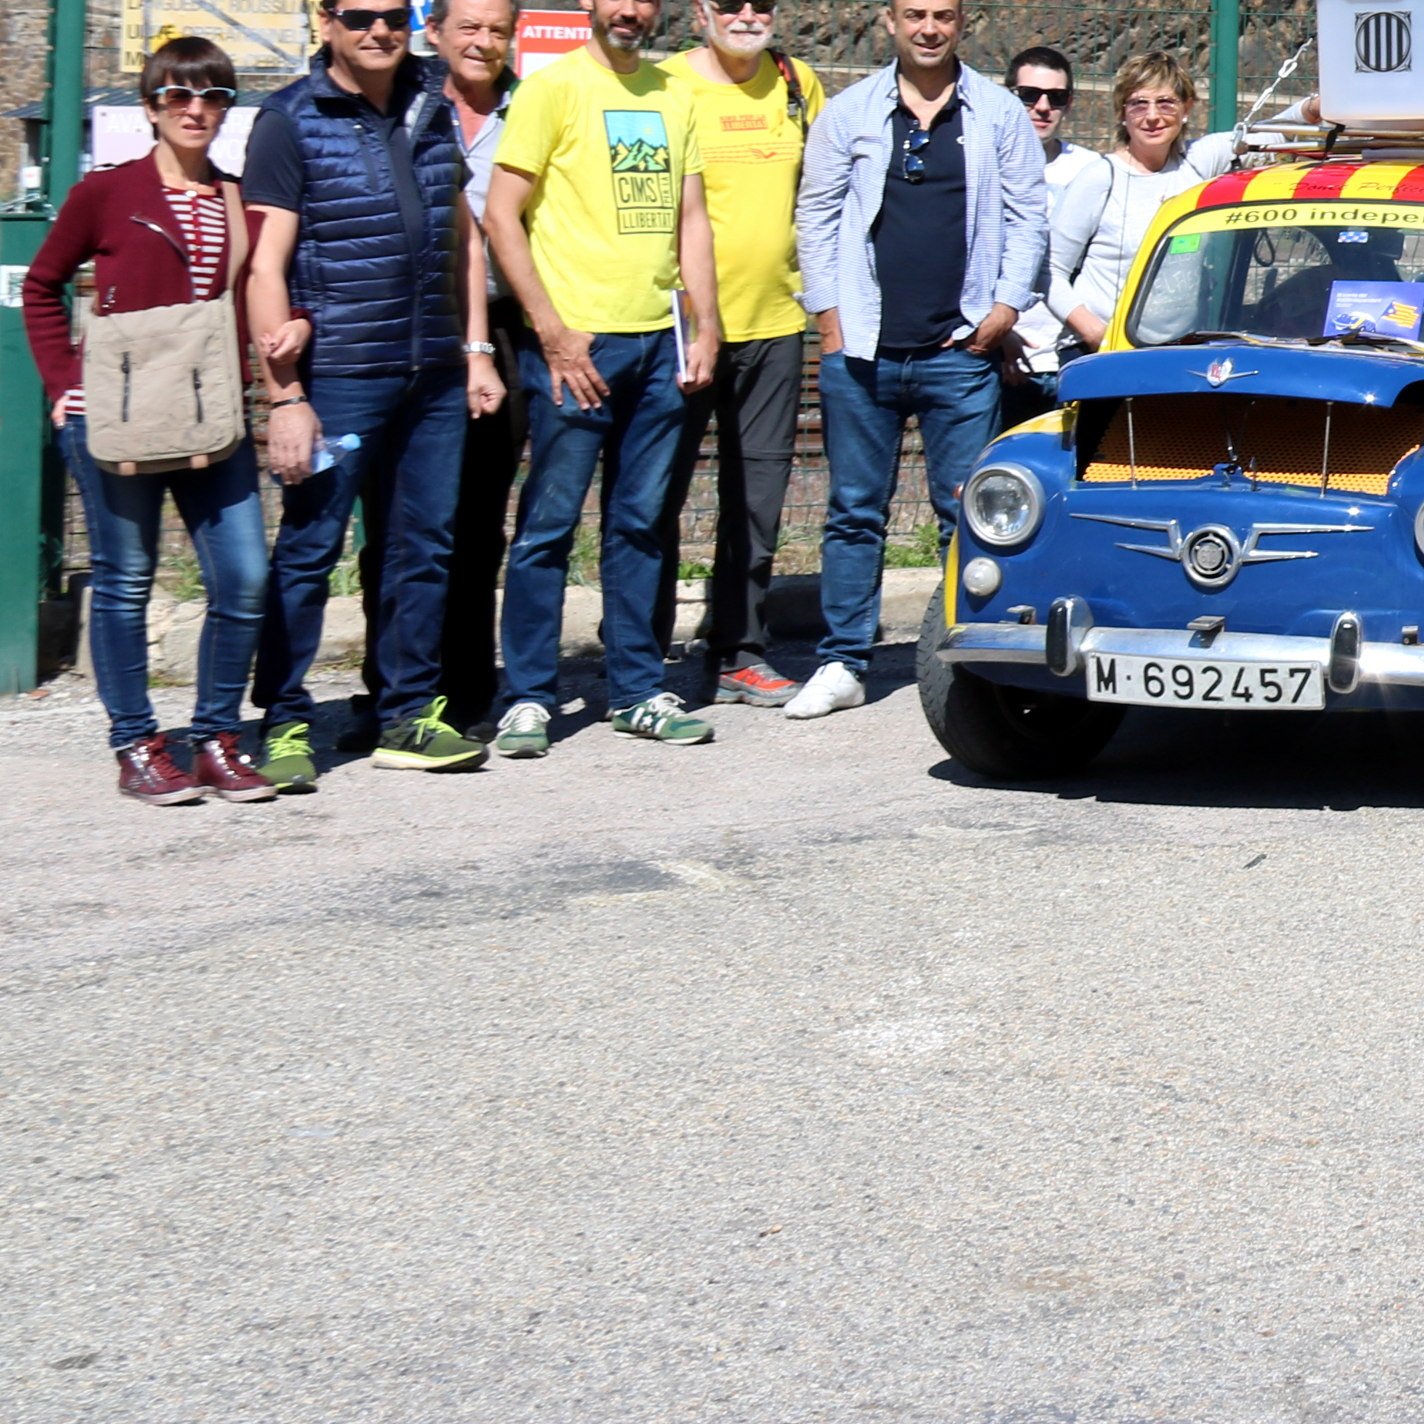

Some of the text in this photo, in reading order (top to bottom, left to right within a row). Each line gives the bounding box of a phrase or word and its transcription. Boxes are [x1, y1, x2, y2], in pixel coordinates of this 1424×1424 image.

[522, 25, 592, 40] ATTENTI
[618, 177, 657, 203] CIMS
[622, 212, 673, 229] LLIBERTAT
[1225, 208, 1298, 225] #600
